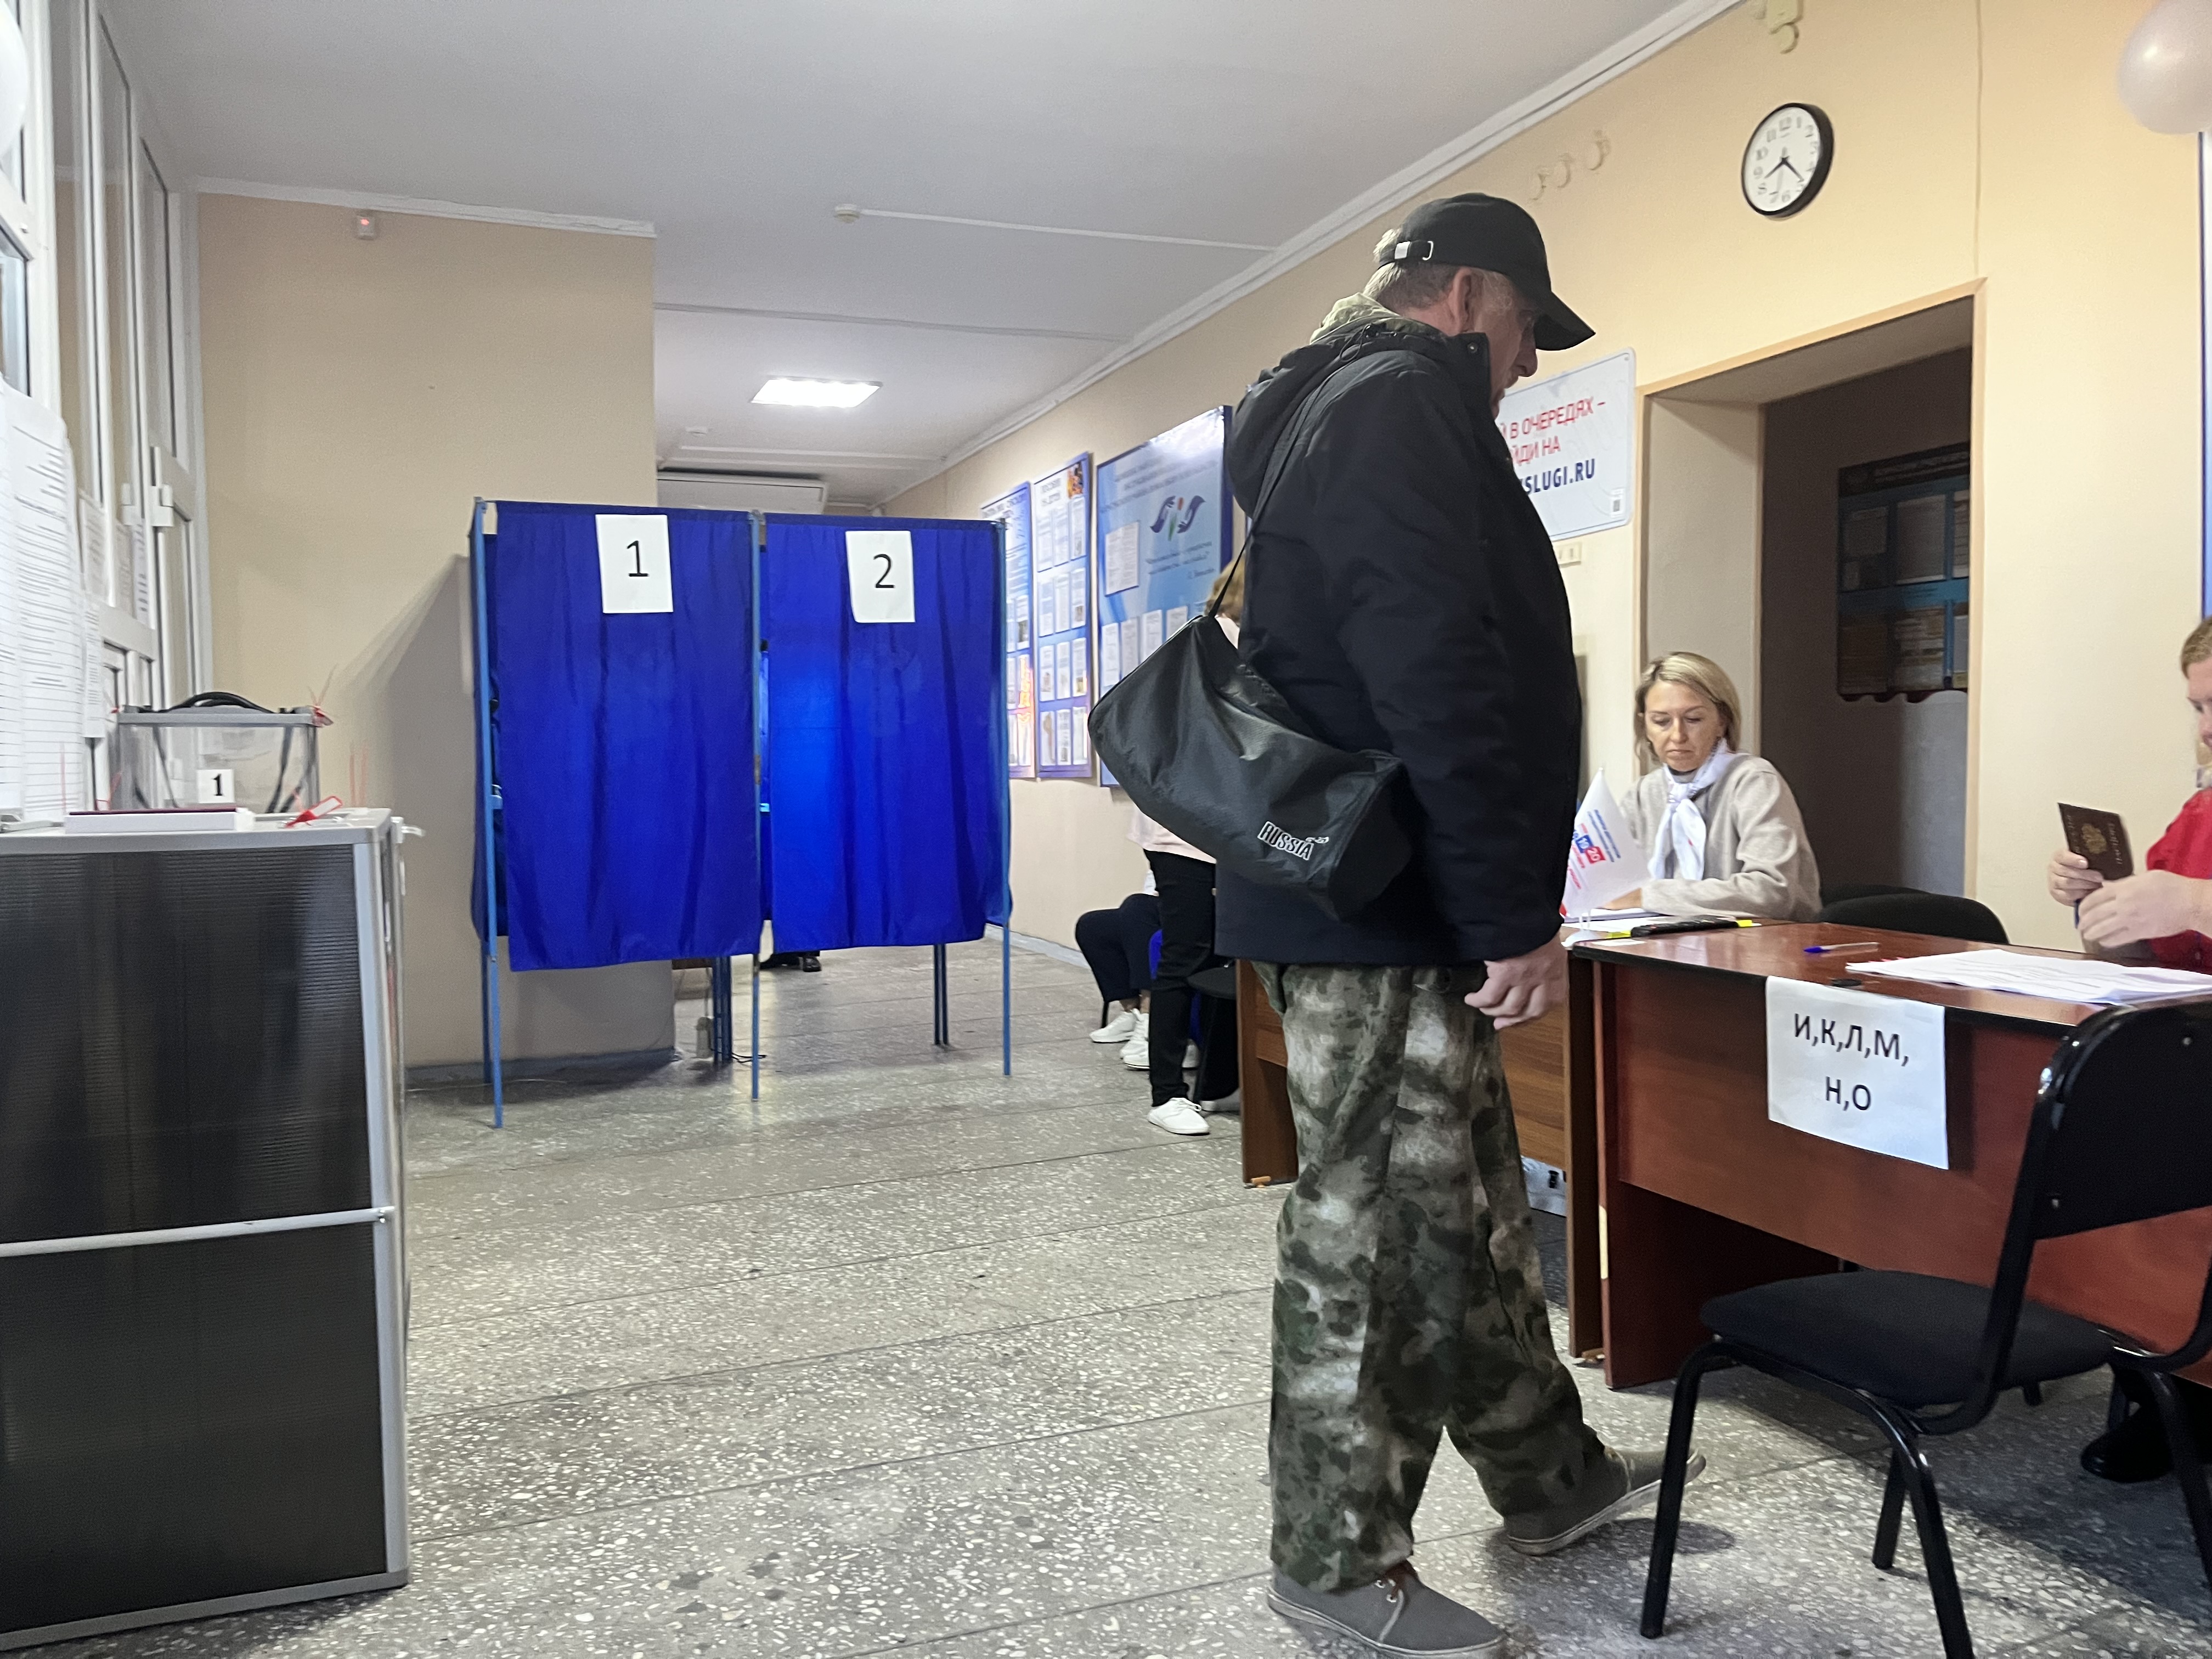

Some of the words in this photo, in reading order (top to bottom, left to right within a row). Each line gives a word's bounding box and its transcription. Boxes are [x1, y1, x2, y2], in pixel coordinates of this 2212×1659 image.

[1510, 422, 1519, 438] В
[1522, 397, 1593, 435] ОЧЕРЕДЯХ
[1542, 435, 1561, 456] НА
[1520, 458, 1595, 494] SLUGI.RU
[627, 540, 649, 577] 1
[873, 554, 895, 588] 2
[212, 774, 224, 796] 1
[1257, 821, 1314, 860] RUSSIA
[1795, 1013, 1909, 1067] И,К,Л,М,
[1825, 1076, 1871, 1111] Н,О
